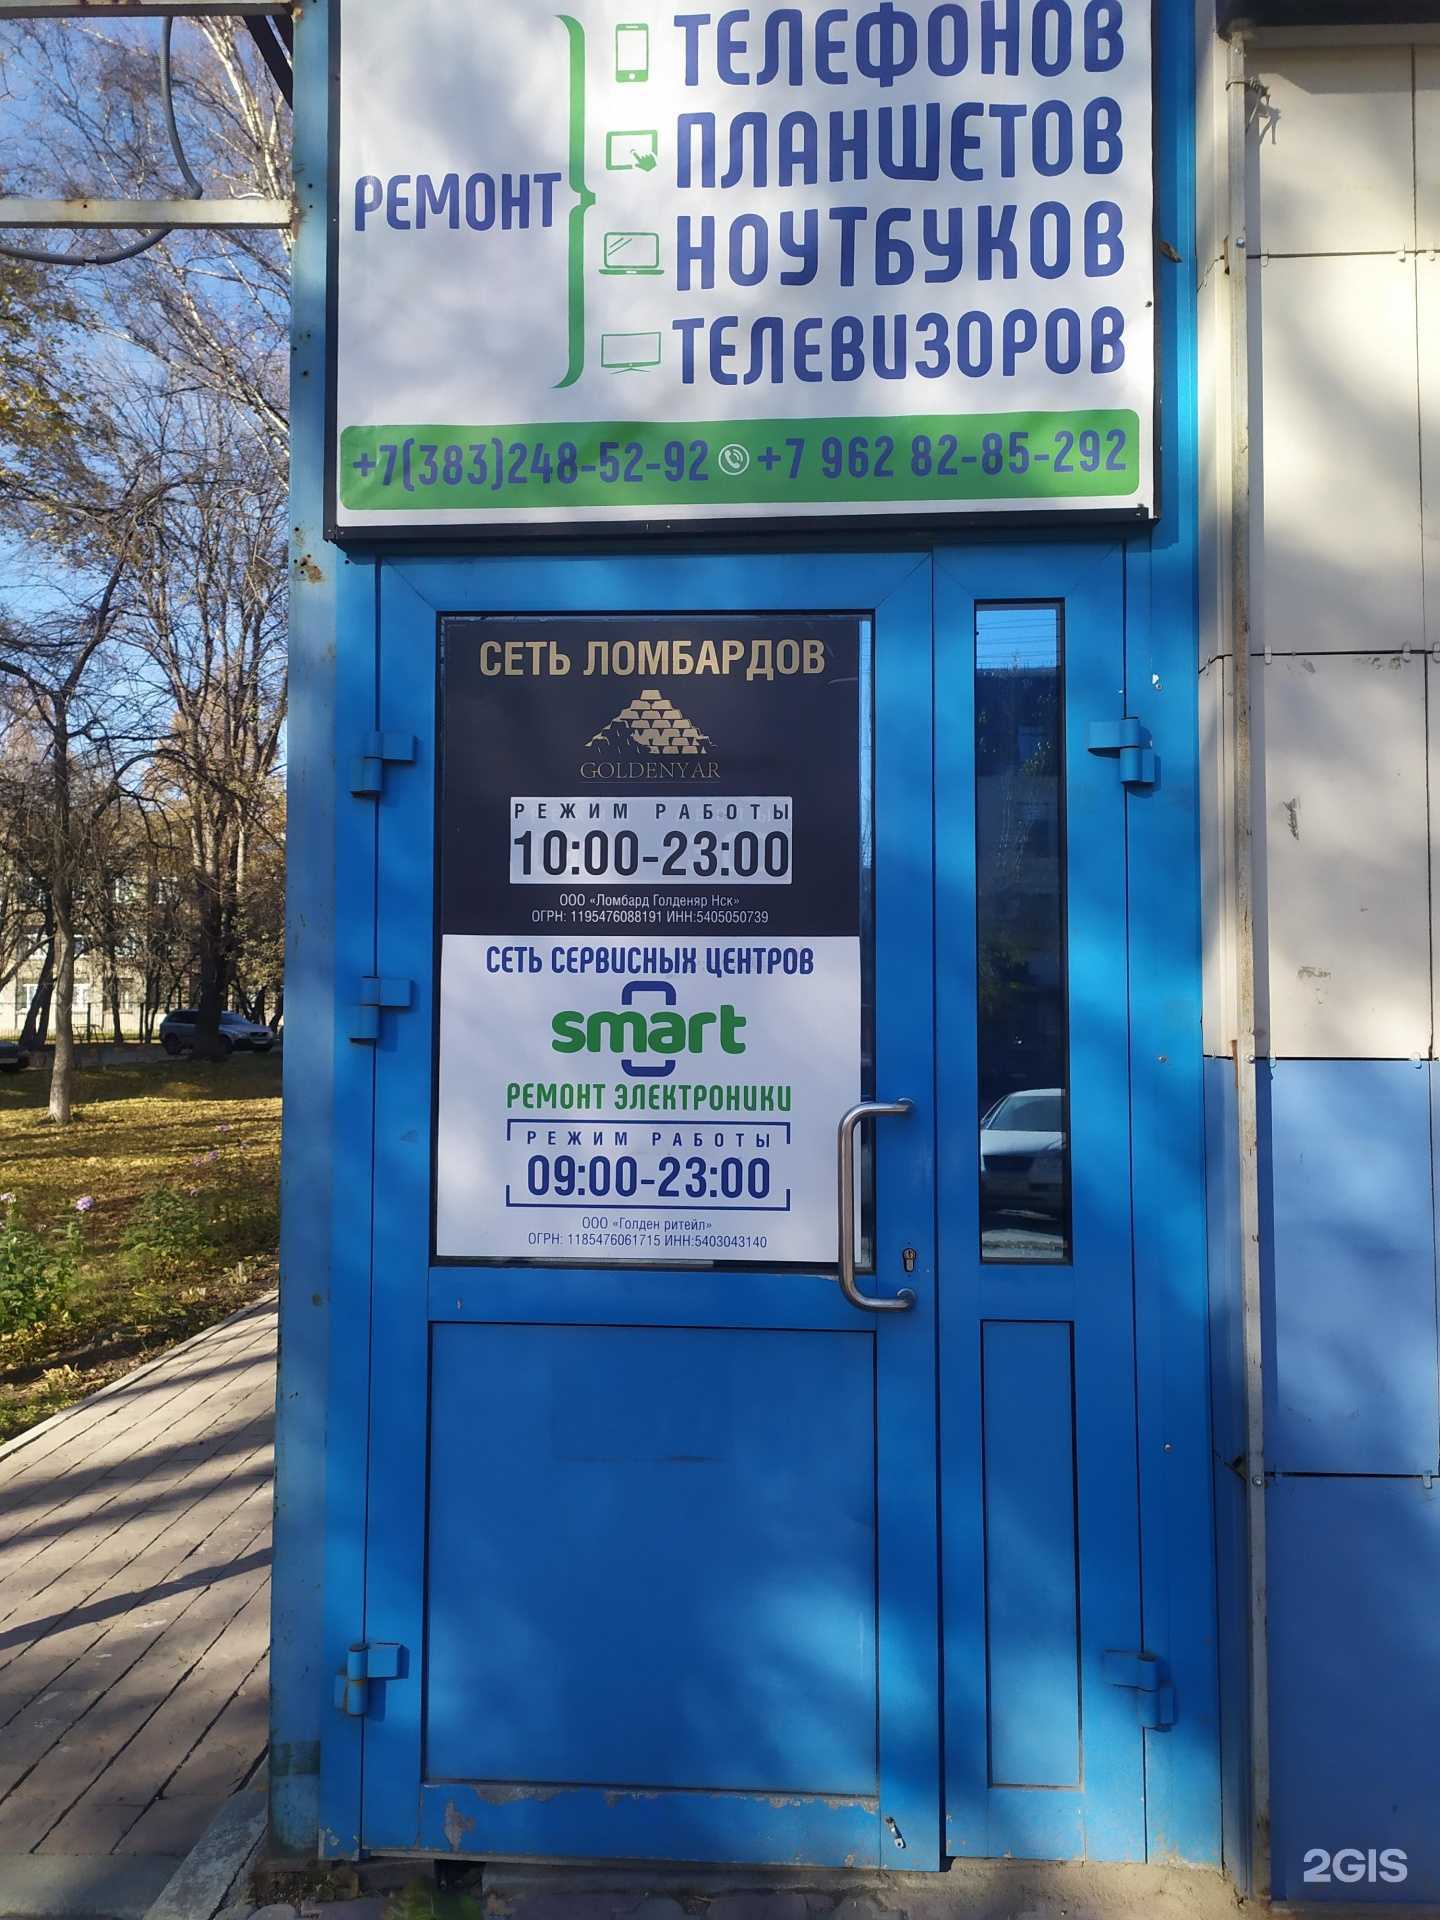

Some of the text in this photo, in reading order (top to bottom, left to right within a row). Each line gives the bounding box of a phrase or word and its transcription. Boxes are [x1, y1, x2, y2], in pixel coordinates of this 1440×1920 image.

[674, 0, 1125, 88] ТЕЛЕФОНОВ
[676, 96, 1123, 189] ПЛАНШЕТОВ
[353, 171, 562, 232] РЕМОНТ
[676, 201, 1125, 291] НОУТБУКОВ
[672, 306, 1126, 386] ТЕЛЕВИЗОРОВ
[352, 438, 710, 492] +7(383)248-52-92
[757, 429, 1127, 479] +7 962 82-85-292
[479, 639, 826, 681] СЕТЬ ЛОМБАРДОВ
[579, 761, 721, 780] GOLDENYAR
[515, 803, 789, 821] РЕЖИМ РАБОТЫ
[514, 829, 789, 876] 10:00-23:00
[531, 910, 567, 922] ОГРН:
[571, 910, 662, 923] 1195476088191
[559, 893, 740, 908] ООО «Ломбард Голденяр Нск»
[486, 946, 814, 978] СЕТЬ СЕРВИСНЫХ ЦЕНТРОВ
[551, 1004, 747, 1055] smart
[506, 1083, 792, 1112] РЕМОНТ ЭЛЕКТРОНИКИ
[526, 1130, 771, 1149] РЕЖИМ РАБОТЫ
[527, 1155, 771, 1199] 09:00-23:00
[527, 1232, 564, 1246] ОГРН:
[567, 1233, 661, 1247] 1185476061715
[581, 1216, 713, 1233] ООО «Голден ритейл»
